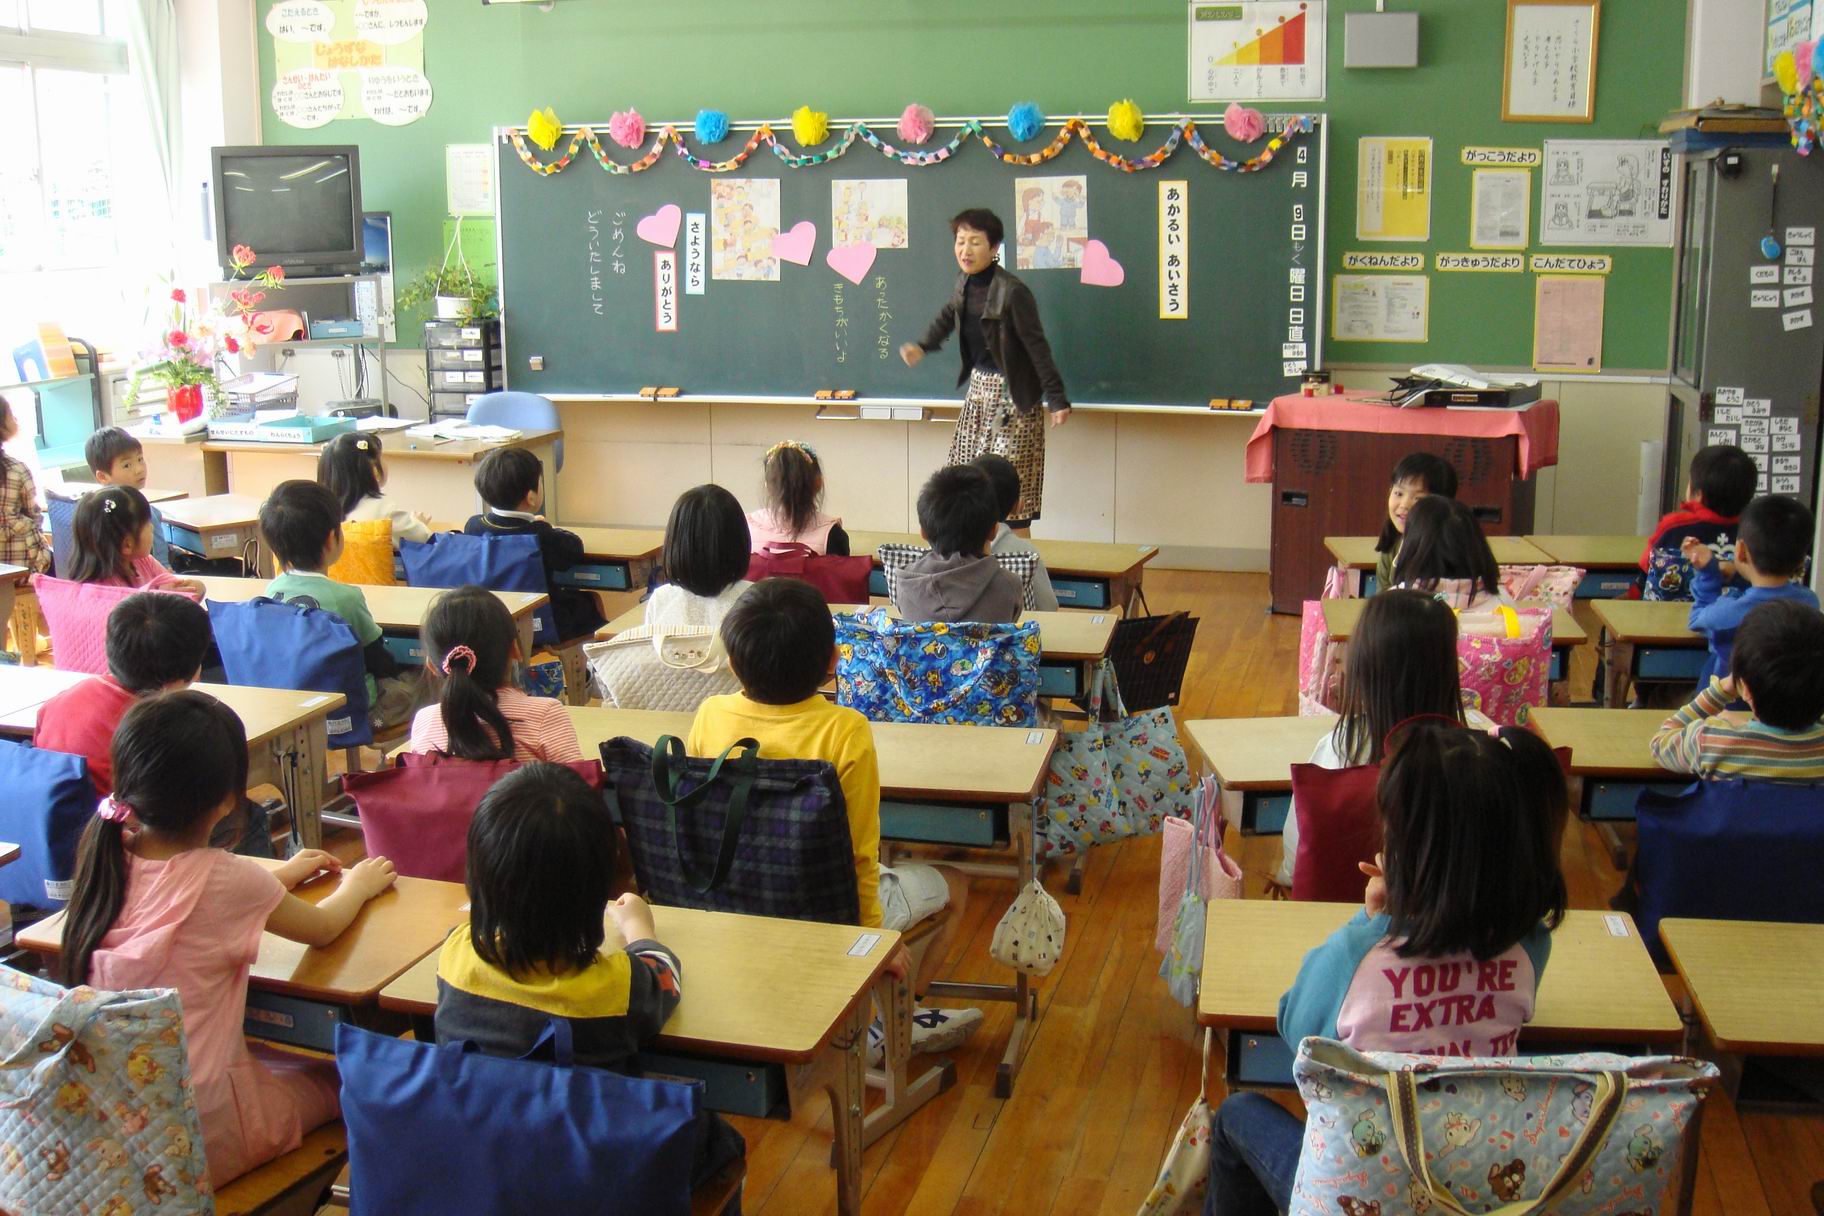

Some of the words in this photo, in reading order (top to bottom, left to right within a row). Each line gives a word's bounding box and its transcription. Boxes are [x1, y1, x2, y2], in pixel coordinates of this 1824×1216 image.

[1465, 149, 1537, 164] がっこうだより
[611, 211, 627, 275] ごめんね
[1167, 187, 1181, 245] あかるい
[587, 209, 605, 316] どういたしまして
[689, 221, 701, 288] さようなら
[1348, 255, 1420, 267] がくねんだより
[1439, 256, 1521, 269] がっきゅうだより
[1533, 257, 1606, 270] こんだてひょう
[660, 259, 673, 324] ありがとう
[875, 276, 893, 360] あったかくなる
[832, 282, 848, 364] きもちがいいよ
[1382, 960, 1517, 999] YOU'RE
[1390, 994, 1496, 1032] EXTRA
